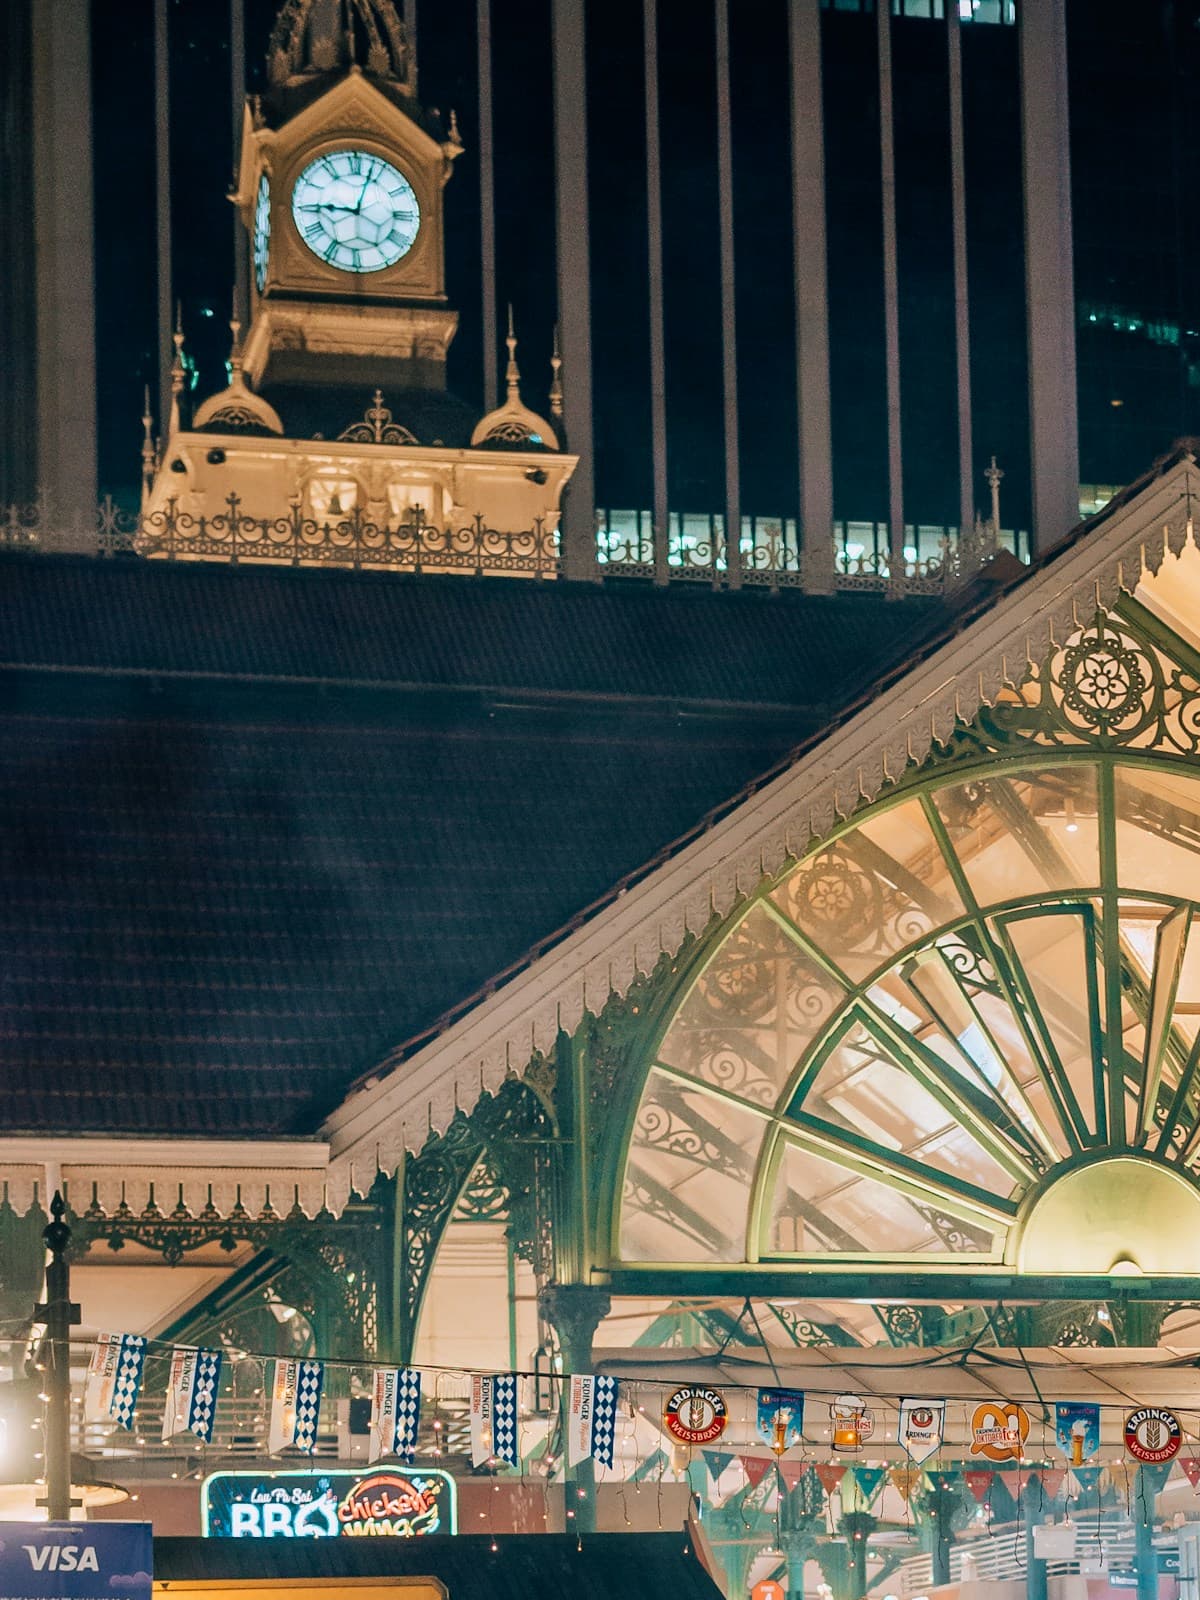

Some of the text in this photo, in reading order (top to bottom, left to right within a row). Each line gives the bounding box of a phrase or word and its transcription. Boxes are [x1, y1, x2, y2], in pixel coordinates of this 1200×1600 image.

[383, 1372, 394, 1417] ERDINGER
[481, 1376, 491, 1420] ERDINGER
[581, 1378, 591, 1421] ERDINGER
[668, 1386, 725, 1413] ERDINGER
[1127, 1408, 1179, 1433] ERDINGER
[250, 1488, 313, 1504] Lau Pa Sat
[338, 1491, 434, 1522] chicken
[231, 1494, 340, 1537] BBQ
[22, 1545, 100, 1571] VISA
